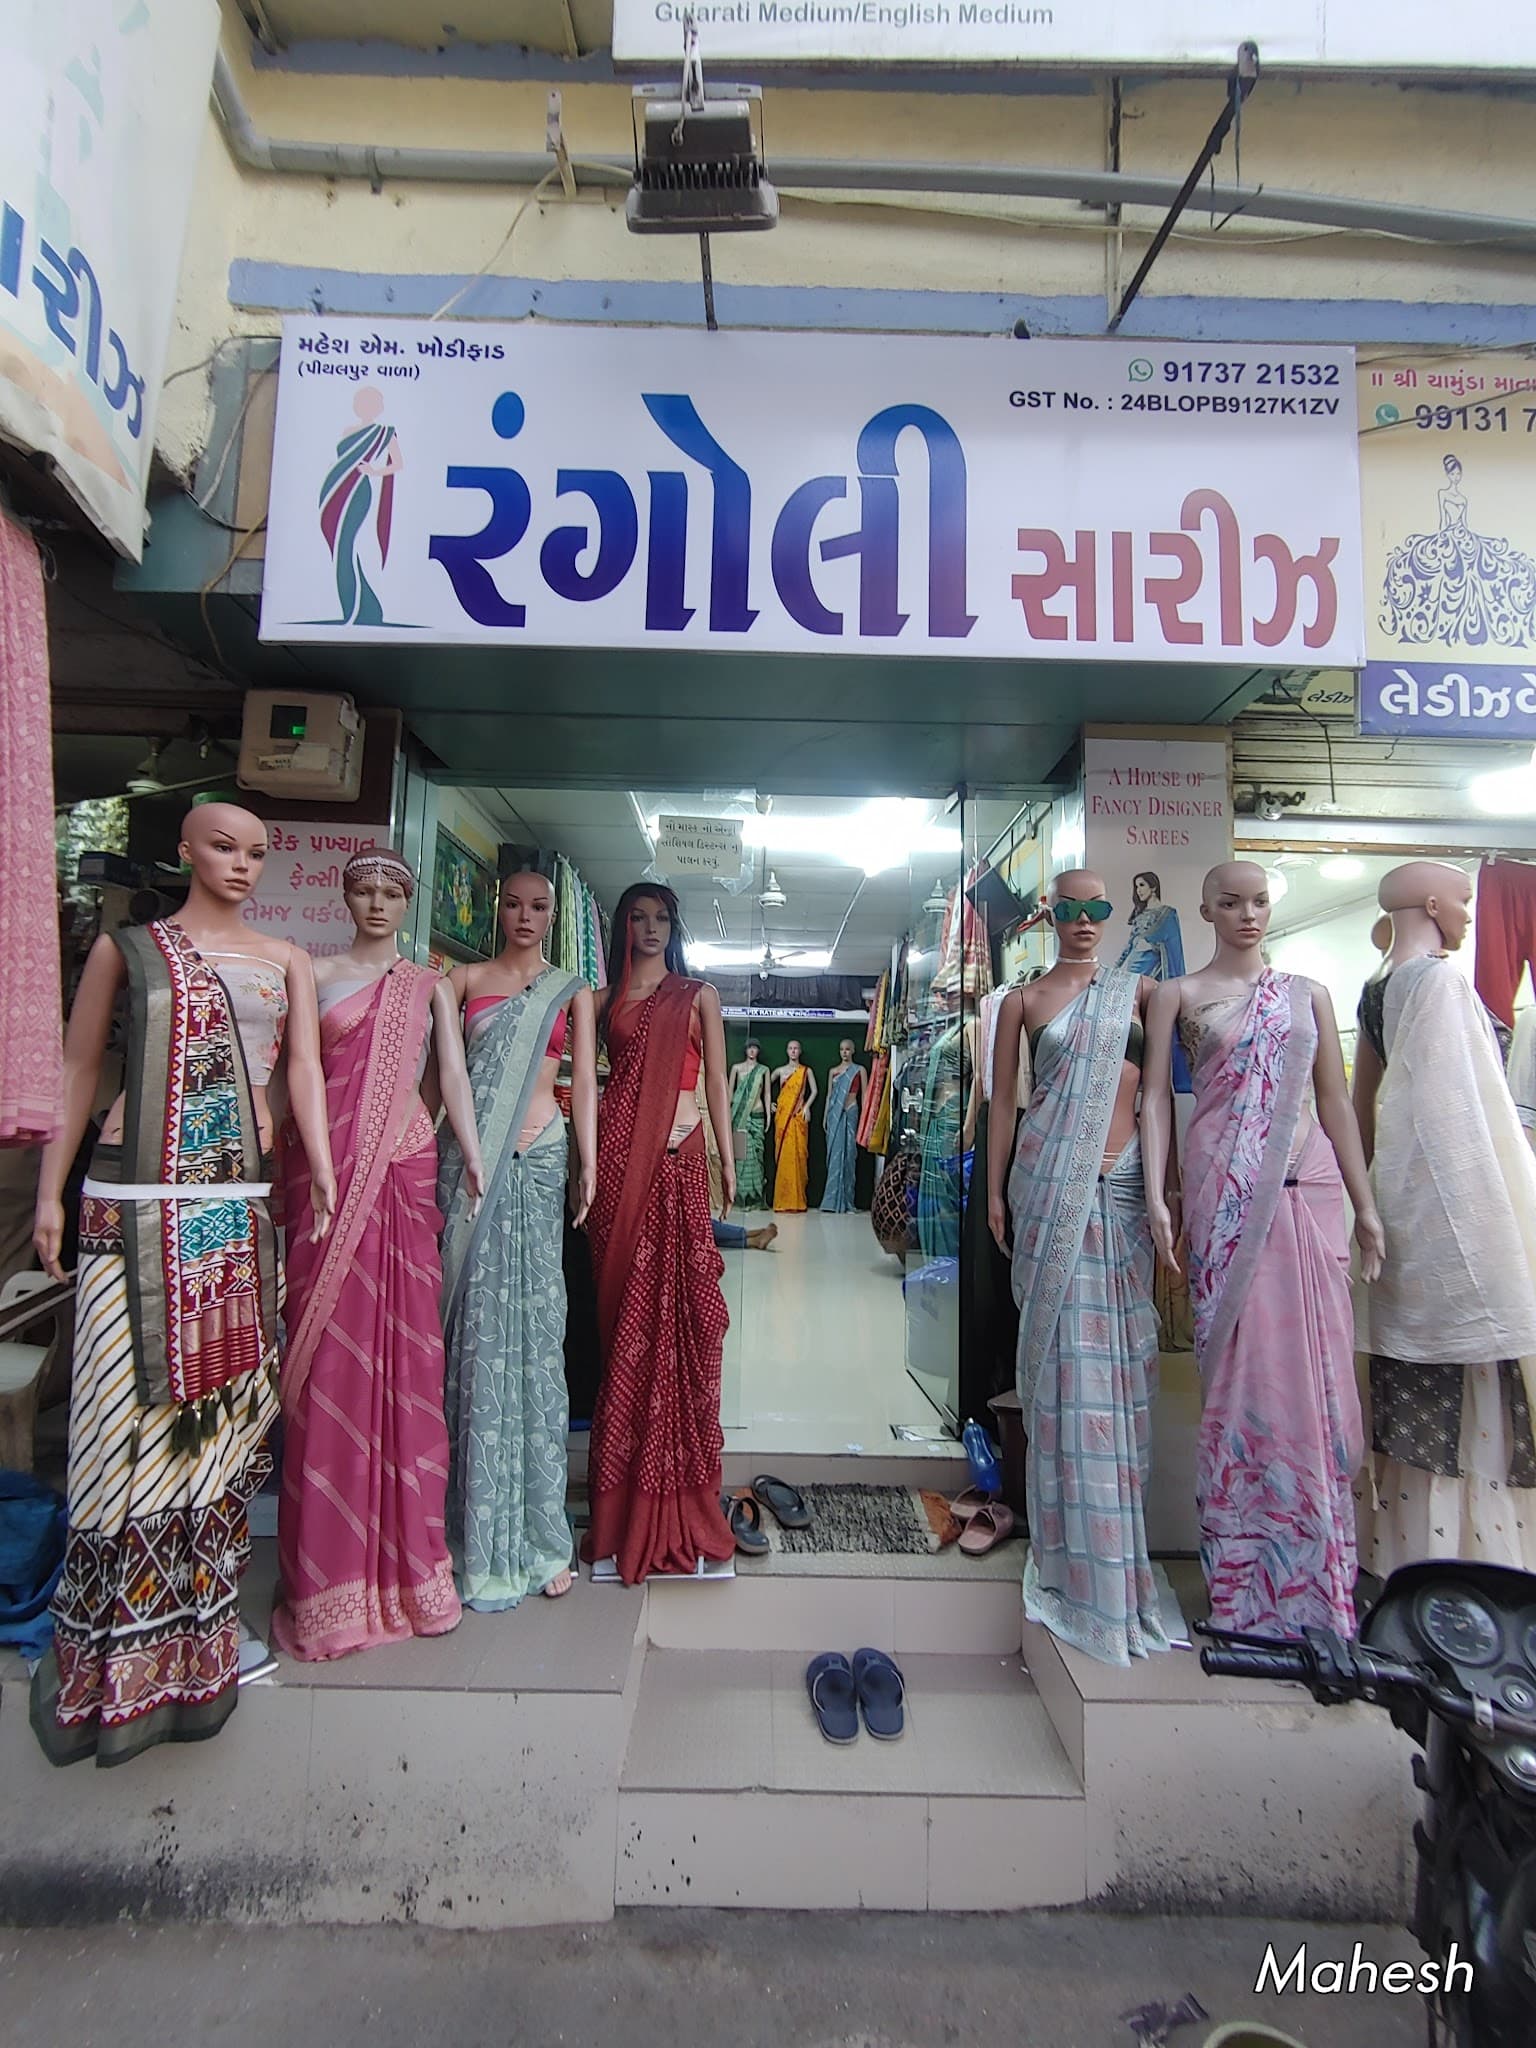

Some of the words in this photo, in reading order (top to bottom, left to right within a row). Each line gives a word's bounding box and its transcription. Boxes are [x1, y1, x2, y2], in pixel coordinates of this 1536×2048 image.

[758, 1, 950, 28] Medium/English
[958, 2, 1054, 25] Medium
[298, 332, 349, 354] મહેશ
[360, 334, 405, 356] એમ.
[417, 336, 505, 362] ખોડીફાડ
[377, 364, 420, 381] વાળા)
[1163, 360, 1247, 383] 91737
[1255, 363, 1340, 385] 21532
[1393, 368, 1418, 388] શ્રી
[1427, 369, 1484, 396] ચામુંડા
[1008, 390, 1056, 409] GST
[1063, 392, 1100, 410] No.
[1120, 393, 1340, 416] 24BLOPB9127K1ZV
[1415, 404, 1508, 433] 99131
[428, 390, 979, 639] રંગોલી
[1010, 487, 1341, 650] સારીઝ
[1108, 767, 1121, 786] A
[1127, 767, 1180, 787] HOUSE
[1092, 795, 1142, 815] FANCY
[1148, 796, 1223, 817] DISIGNER
[267, 826, 300, 851] રેક
[1126, 825, 1190, 846] SAREES
[289, 863, 340, 890] ફેન્સી
[242, 896, 292, 922] તેમજ
